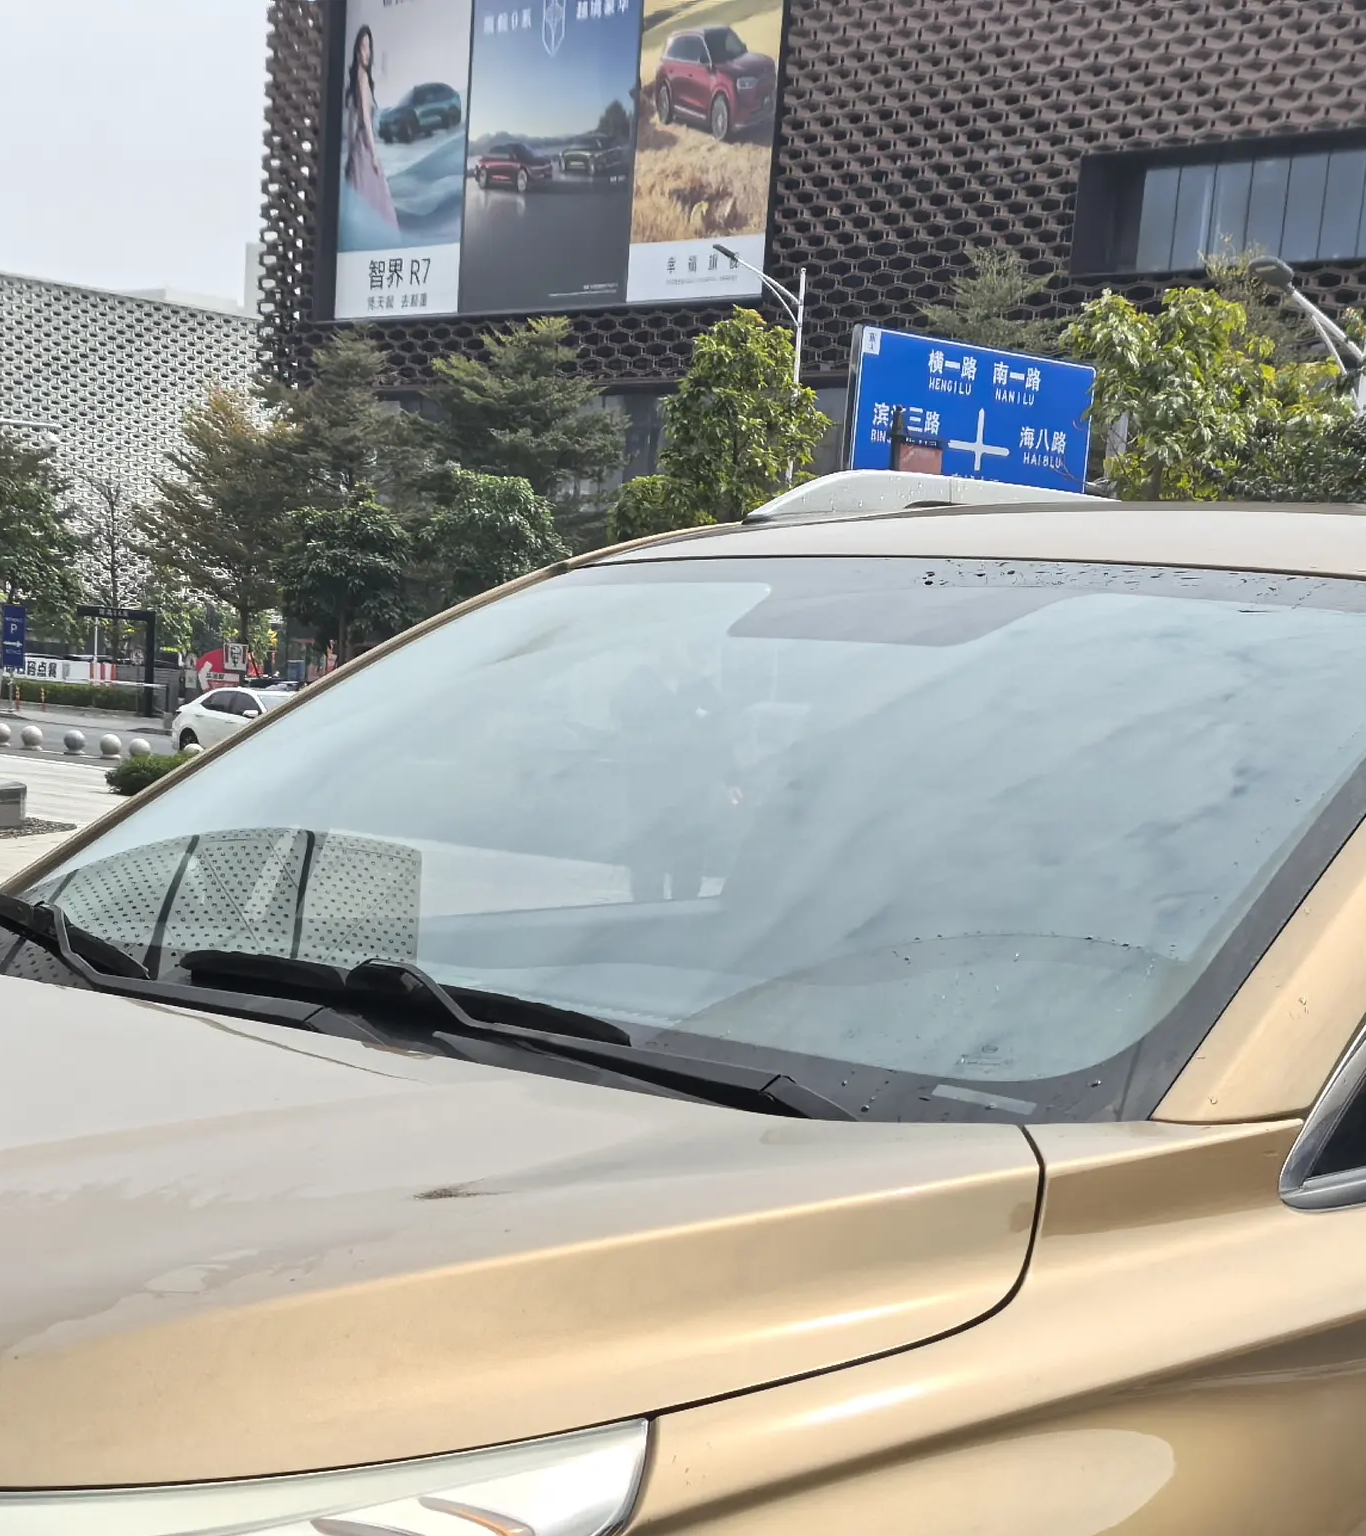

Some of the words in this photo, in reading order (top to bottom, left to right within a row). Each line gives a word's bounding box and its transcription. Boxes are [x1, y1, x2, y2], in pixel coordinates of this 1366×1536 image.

[368, 257, 403, 290] 智界
[410, 257, 431, 286] R7
[928, 349, 977, 381] 横一路
[993, 361, 1041, 392] 南一路
[1019, 425, 1066, 455] 海八路
[10, 623, 18, 634] P
